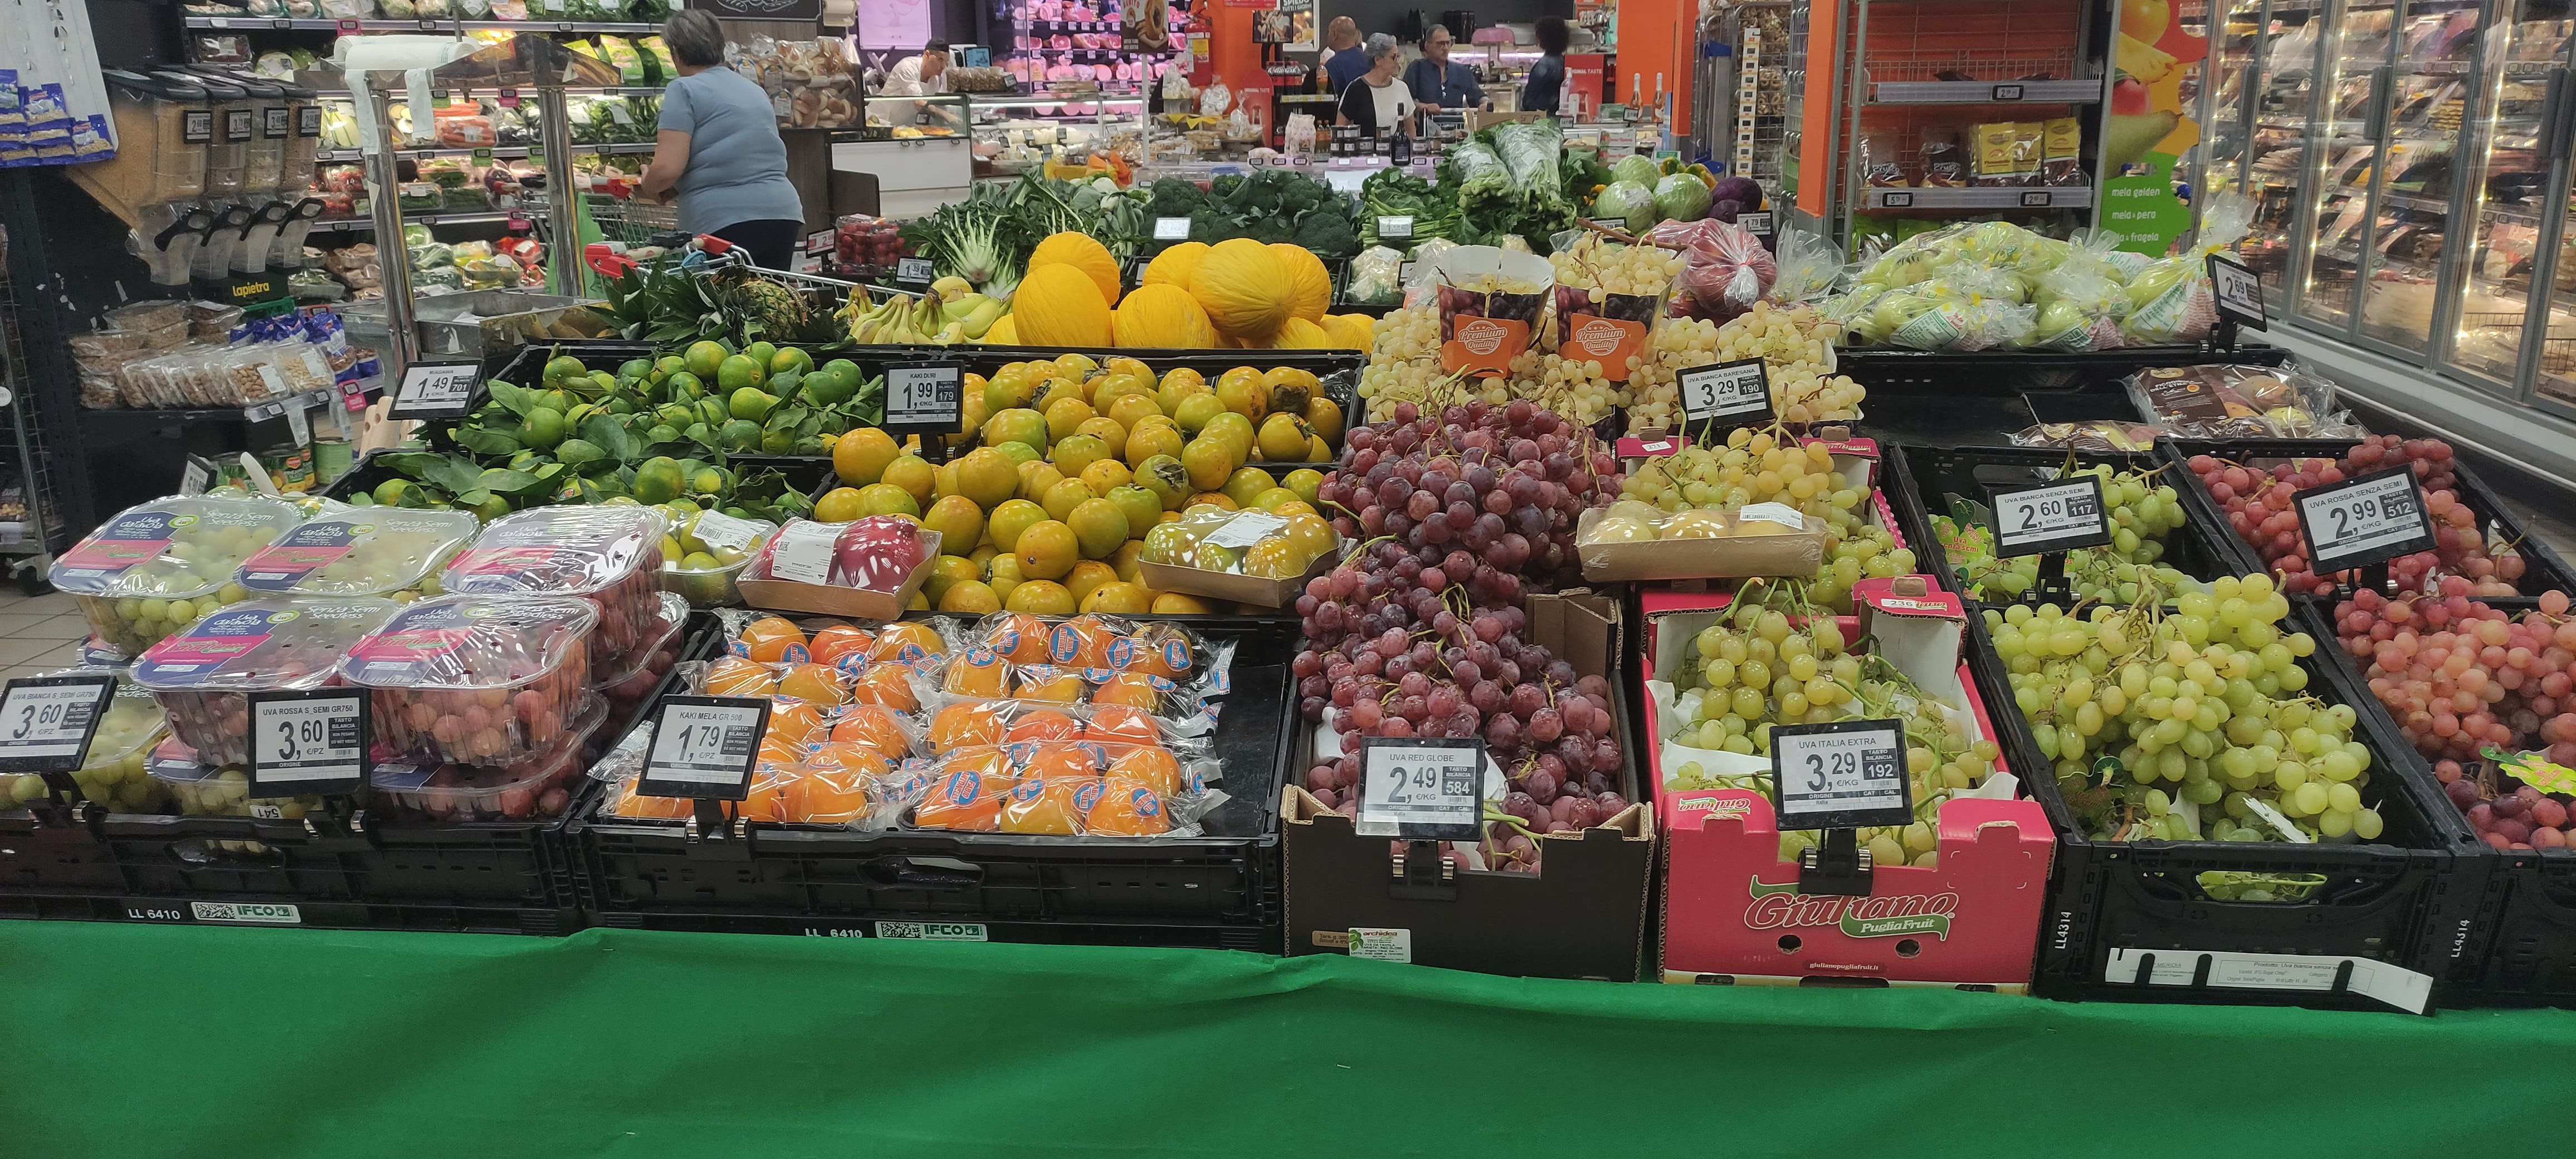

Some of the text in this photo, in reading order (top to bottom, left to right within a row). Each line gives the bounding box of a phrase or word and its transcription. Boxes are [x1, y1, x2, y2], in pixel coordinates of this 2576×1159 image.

[2112, 187, 2160, 198] mela golden
[2112, 211, 2156, 220] mela pera
[2131, 232, 2159, 243] fragola
[1460, 328, 1506, 342] Premium
[1578, 328, 1624, 342] Premium
[1467, 339, 1497, 350] Quality
[1585, 340, 1615, 350] Quality
[1724, 368, 1755, 377] BARESANA
[452, 383, 467, 392] 701
[1742, 384, 1759, 394] 190
[939, 391, 954, 401] 179
[2310, 480, 2402, 509] UVA ROSSA SENZA SEMI
[2019, 500, 2061, 529] 2,60
[2071, 504, 2093, 515] 117
[2387, 501, 2413, 517] 512
[142, 516, 160, 524] Uva
[203, 510, 277, 522] Senza Semi
[2330, 499, 2377, 539] 2,99
[209, 517, 259, 527] Seedless
[383, 519, 453, 528] Senza Semi
[2362, 520, 2382, 530] €/KG
[547, 607, 580, 615] Semi
[1057, 627, 1068, 660] ANTONELLI
[331, 704, 353, 713] GR750
[13, 704, 61, 739] 3,60
[279, 719, 323, 760] 3,60
[679, 724, 720, 762] 1,79
[1799, 741, 1816, 749] UVA
[1818, 739, 1845, 748] ITALIA
[1806, 752, 1856, 791] 3,29
[1868, 763, 1894, 777] 192
[964, 780, 976, 799] FABIO
[1387, 767, 1436, 803] 2,49
[1446, 781, 1470, 794] 584
[257, 808, 279, 819] 541
[128, 908, 180, 920] LL 6410
[236, 905, 275, 916] IFCO
[1744, 892, 1959, 929] Giuliano
[805, 928, 862, 938] LL 6410
[924, 924, 963, 935] IFCO
[2055, 910, 2072, 950] LL4314
[2451, 919, 2470, 958] LL4314
[1809, 962, 1879, 971] giulianopugliafruit.it
